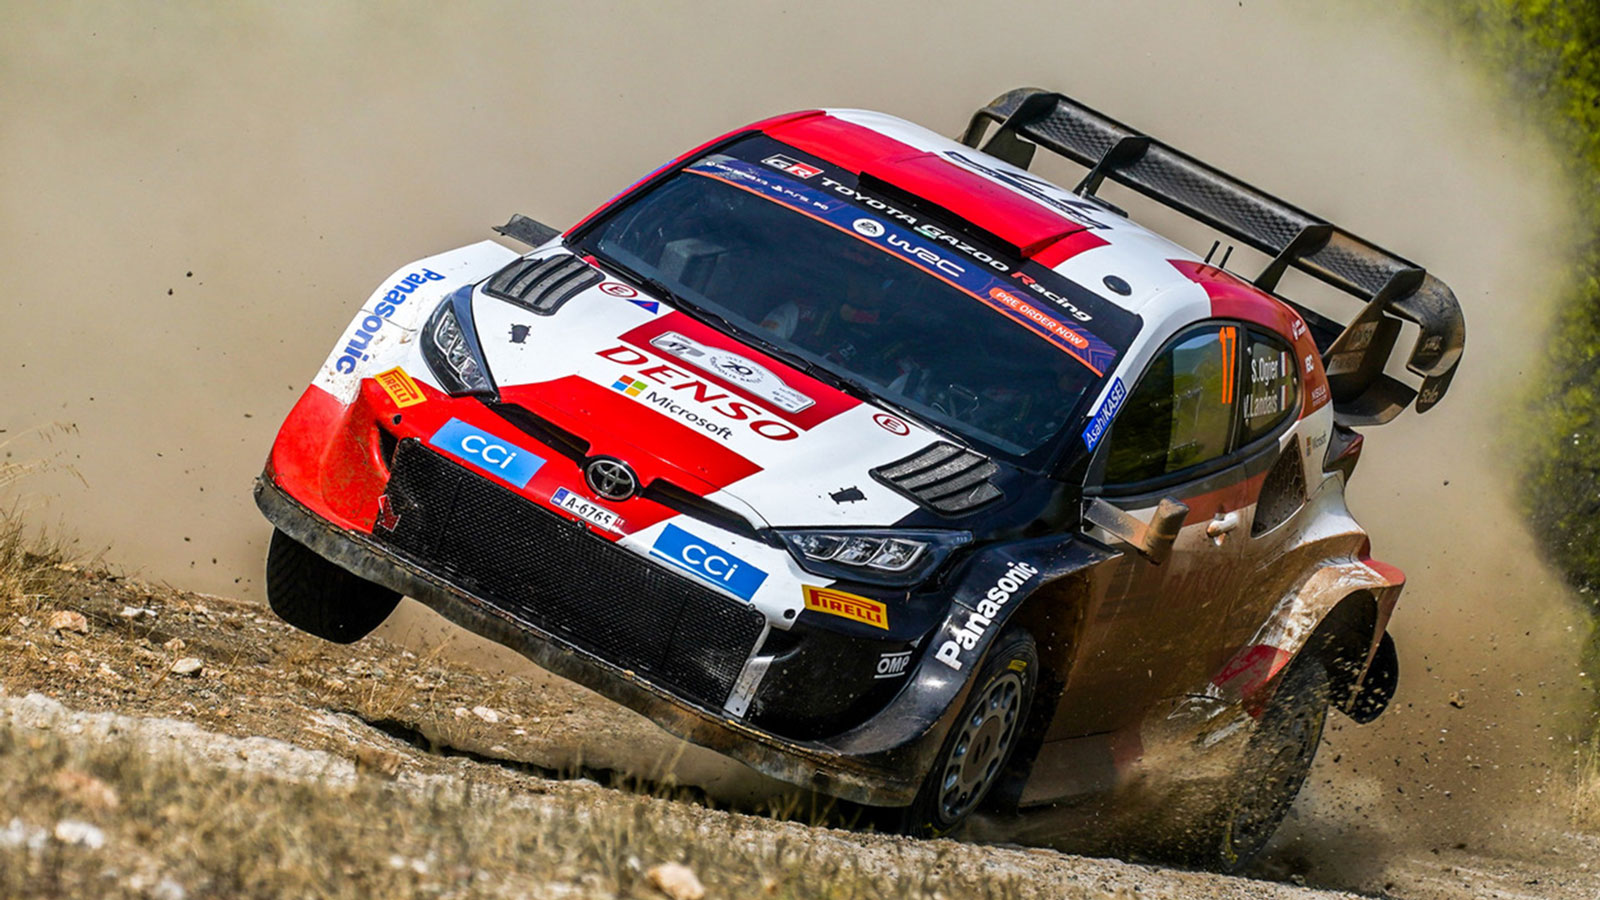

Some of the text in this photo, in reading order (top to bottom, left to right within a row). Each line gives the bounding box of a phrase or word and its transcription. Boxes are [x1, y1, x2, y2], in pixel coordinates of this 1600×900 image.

[821, 177, 917, 225] TOYOTA
[915, 224, 1009, 273] GAZOO
[1011, 271, 1093, 322] Racing
[887, 234, 966, 277] WRC
[335, 268, 446, 375] Panasonic
[996, 290, 1084, 345] PRE ORDER NOW
[380, 369, 419, 403] PIRELLI
[595, 345, 799, 441] DENSO
[646, 391, 734, 440] Microsoft
[565, 497, 612, 524] A-6765
[809, 588, 882, 624] PIRELLI
[935, 561, 1039, 671] Panasonic
[876, 654, 910, 675] OMP
